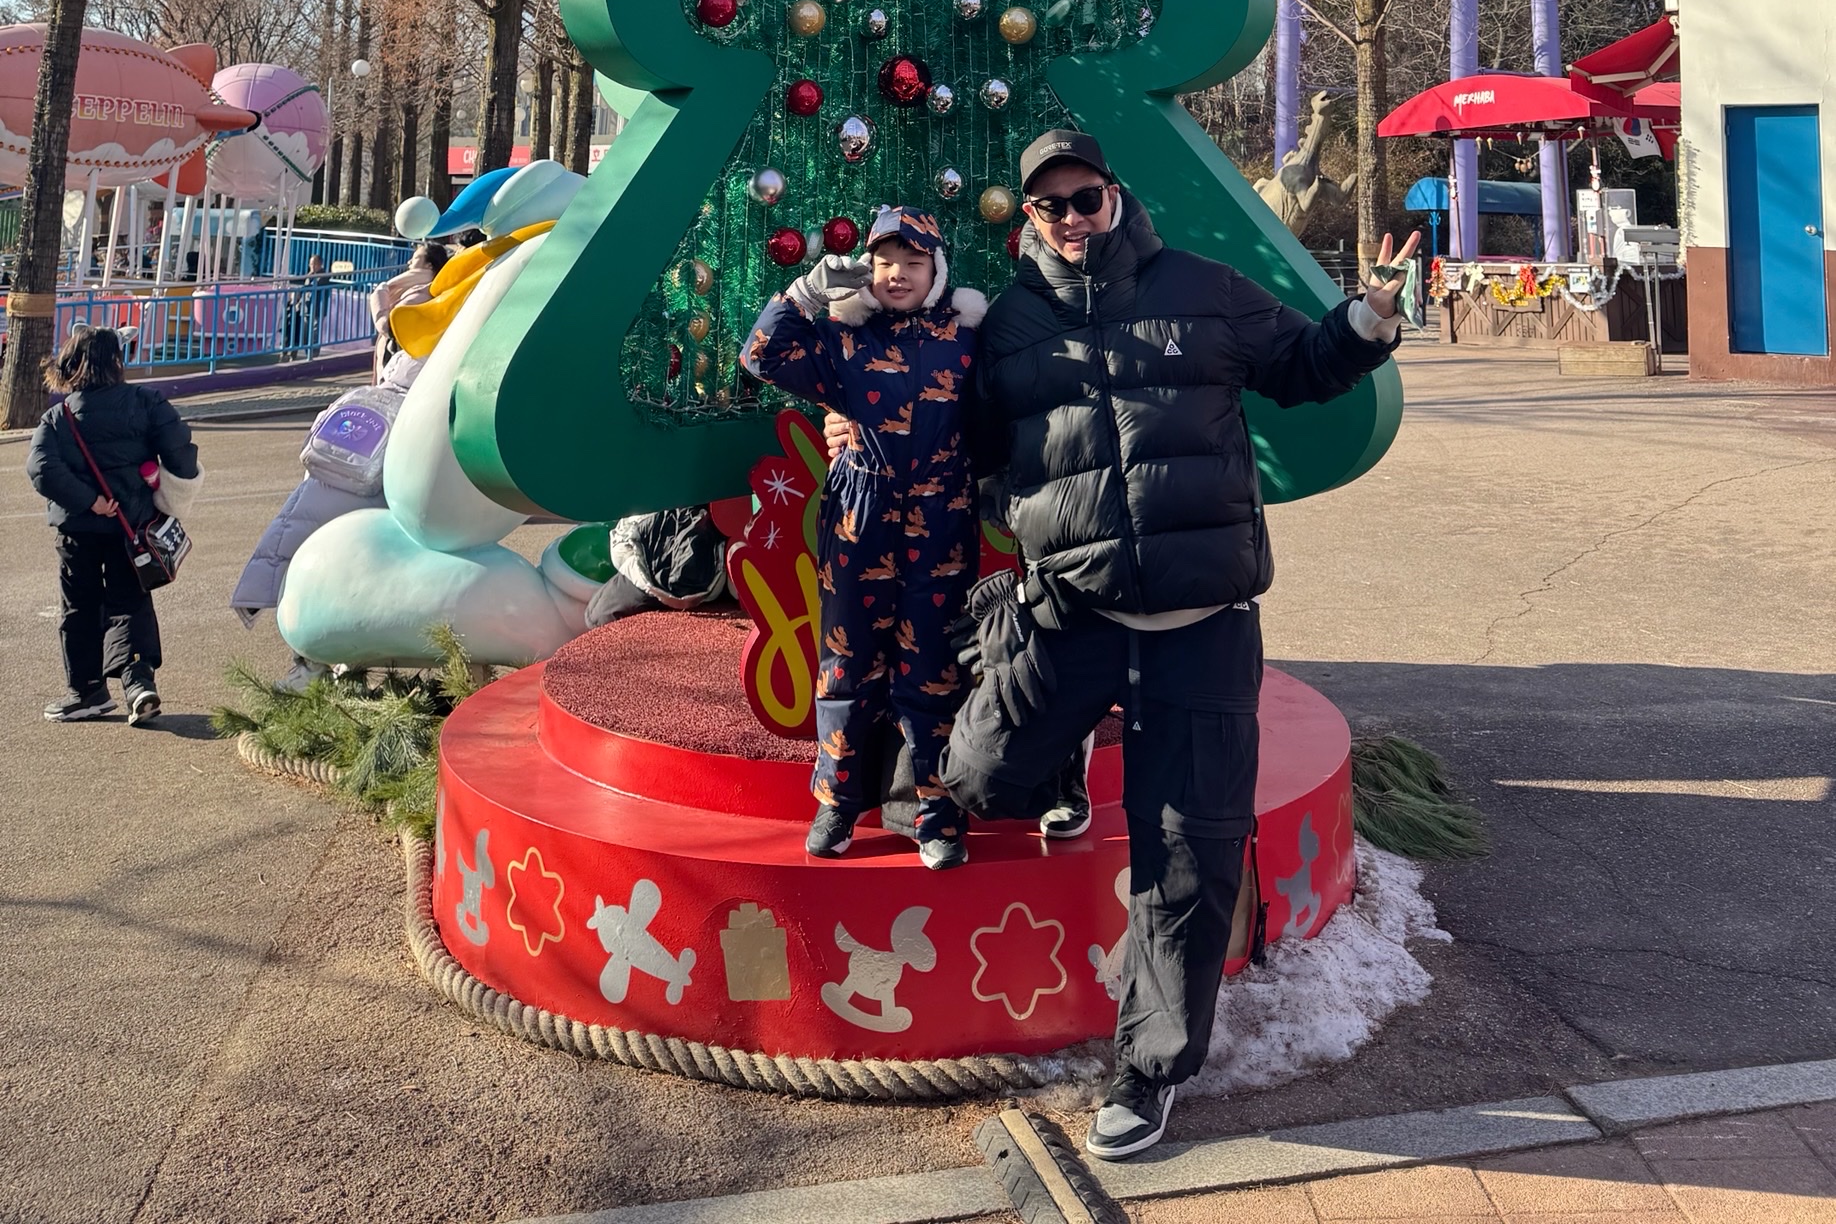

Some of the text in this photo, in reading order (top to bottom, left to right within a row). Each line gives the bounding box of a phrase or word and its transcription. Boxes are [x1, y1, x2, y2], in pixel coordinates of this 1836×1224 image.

[71, 93, 186, 128] EPPELIN
[1453, 89, 1495, 116] MERHABA
[1039, 141, 1072, 155] GORE-TEX
